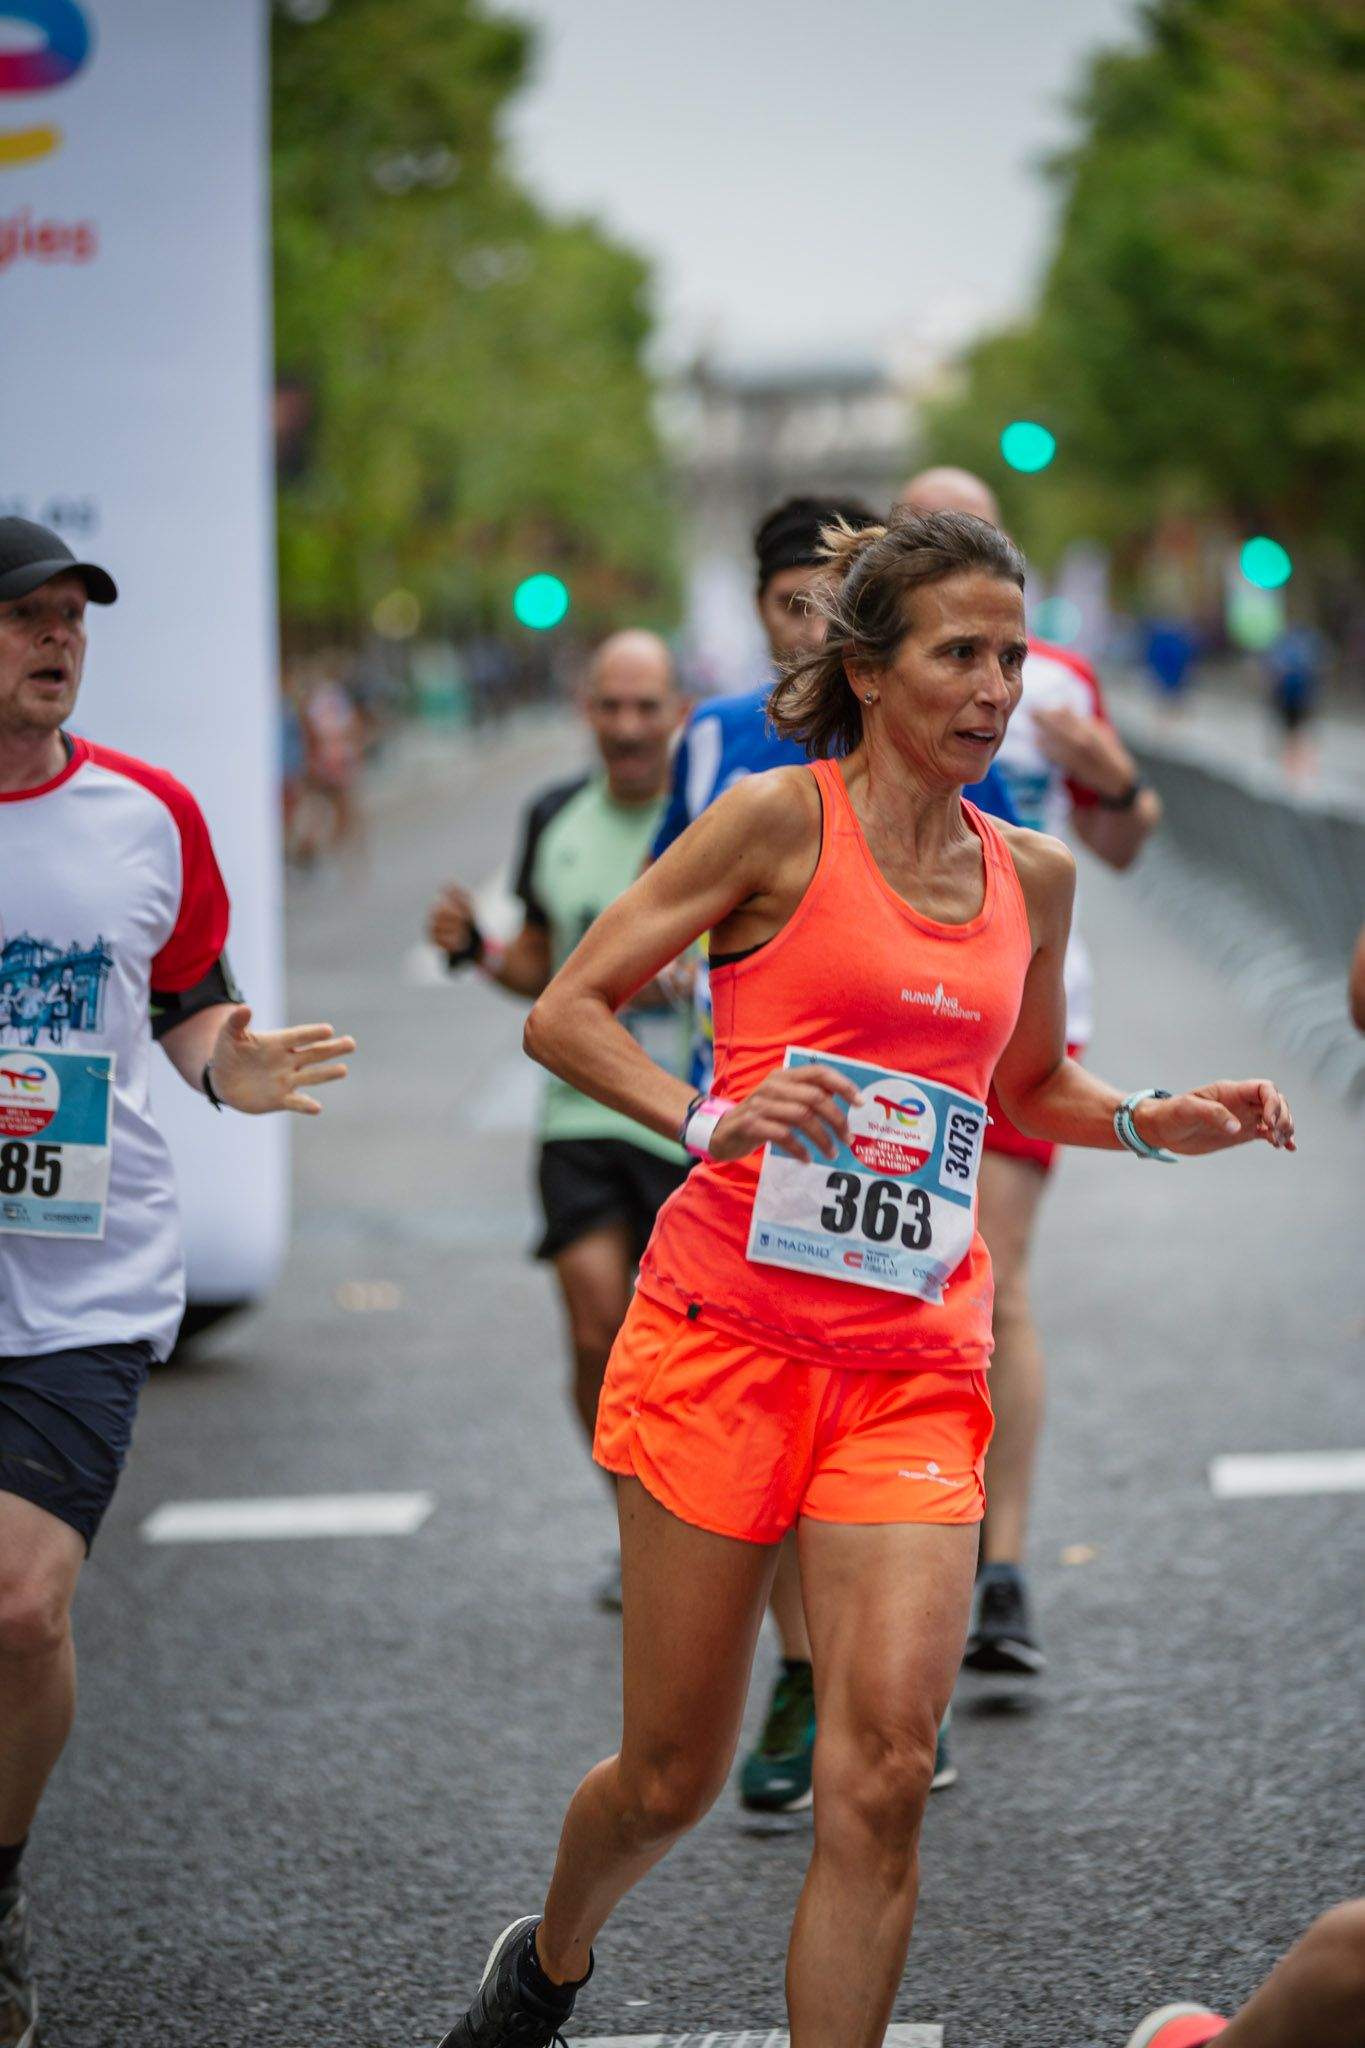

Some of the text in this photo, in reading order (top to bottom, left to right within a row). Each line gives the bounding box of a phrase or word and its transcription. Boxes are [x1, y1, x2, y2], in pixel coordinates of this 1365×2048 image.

[0, 1142, 62, 1197] 85
[945, 1114, 980, 1181] 3473
[820, 1171, 933, 1251] 363
[777, 1238, 830, 1259] MADRID
